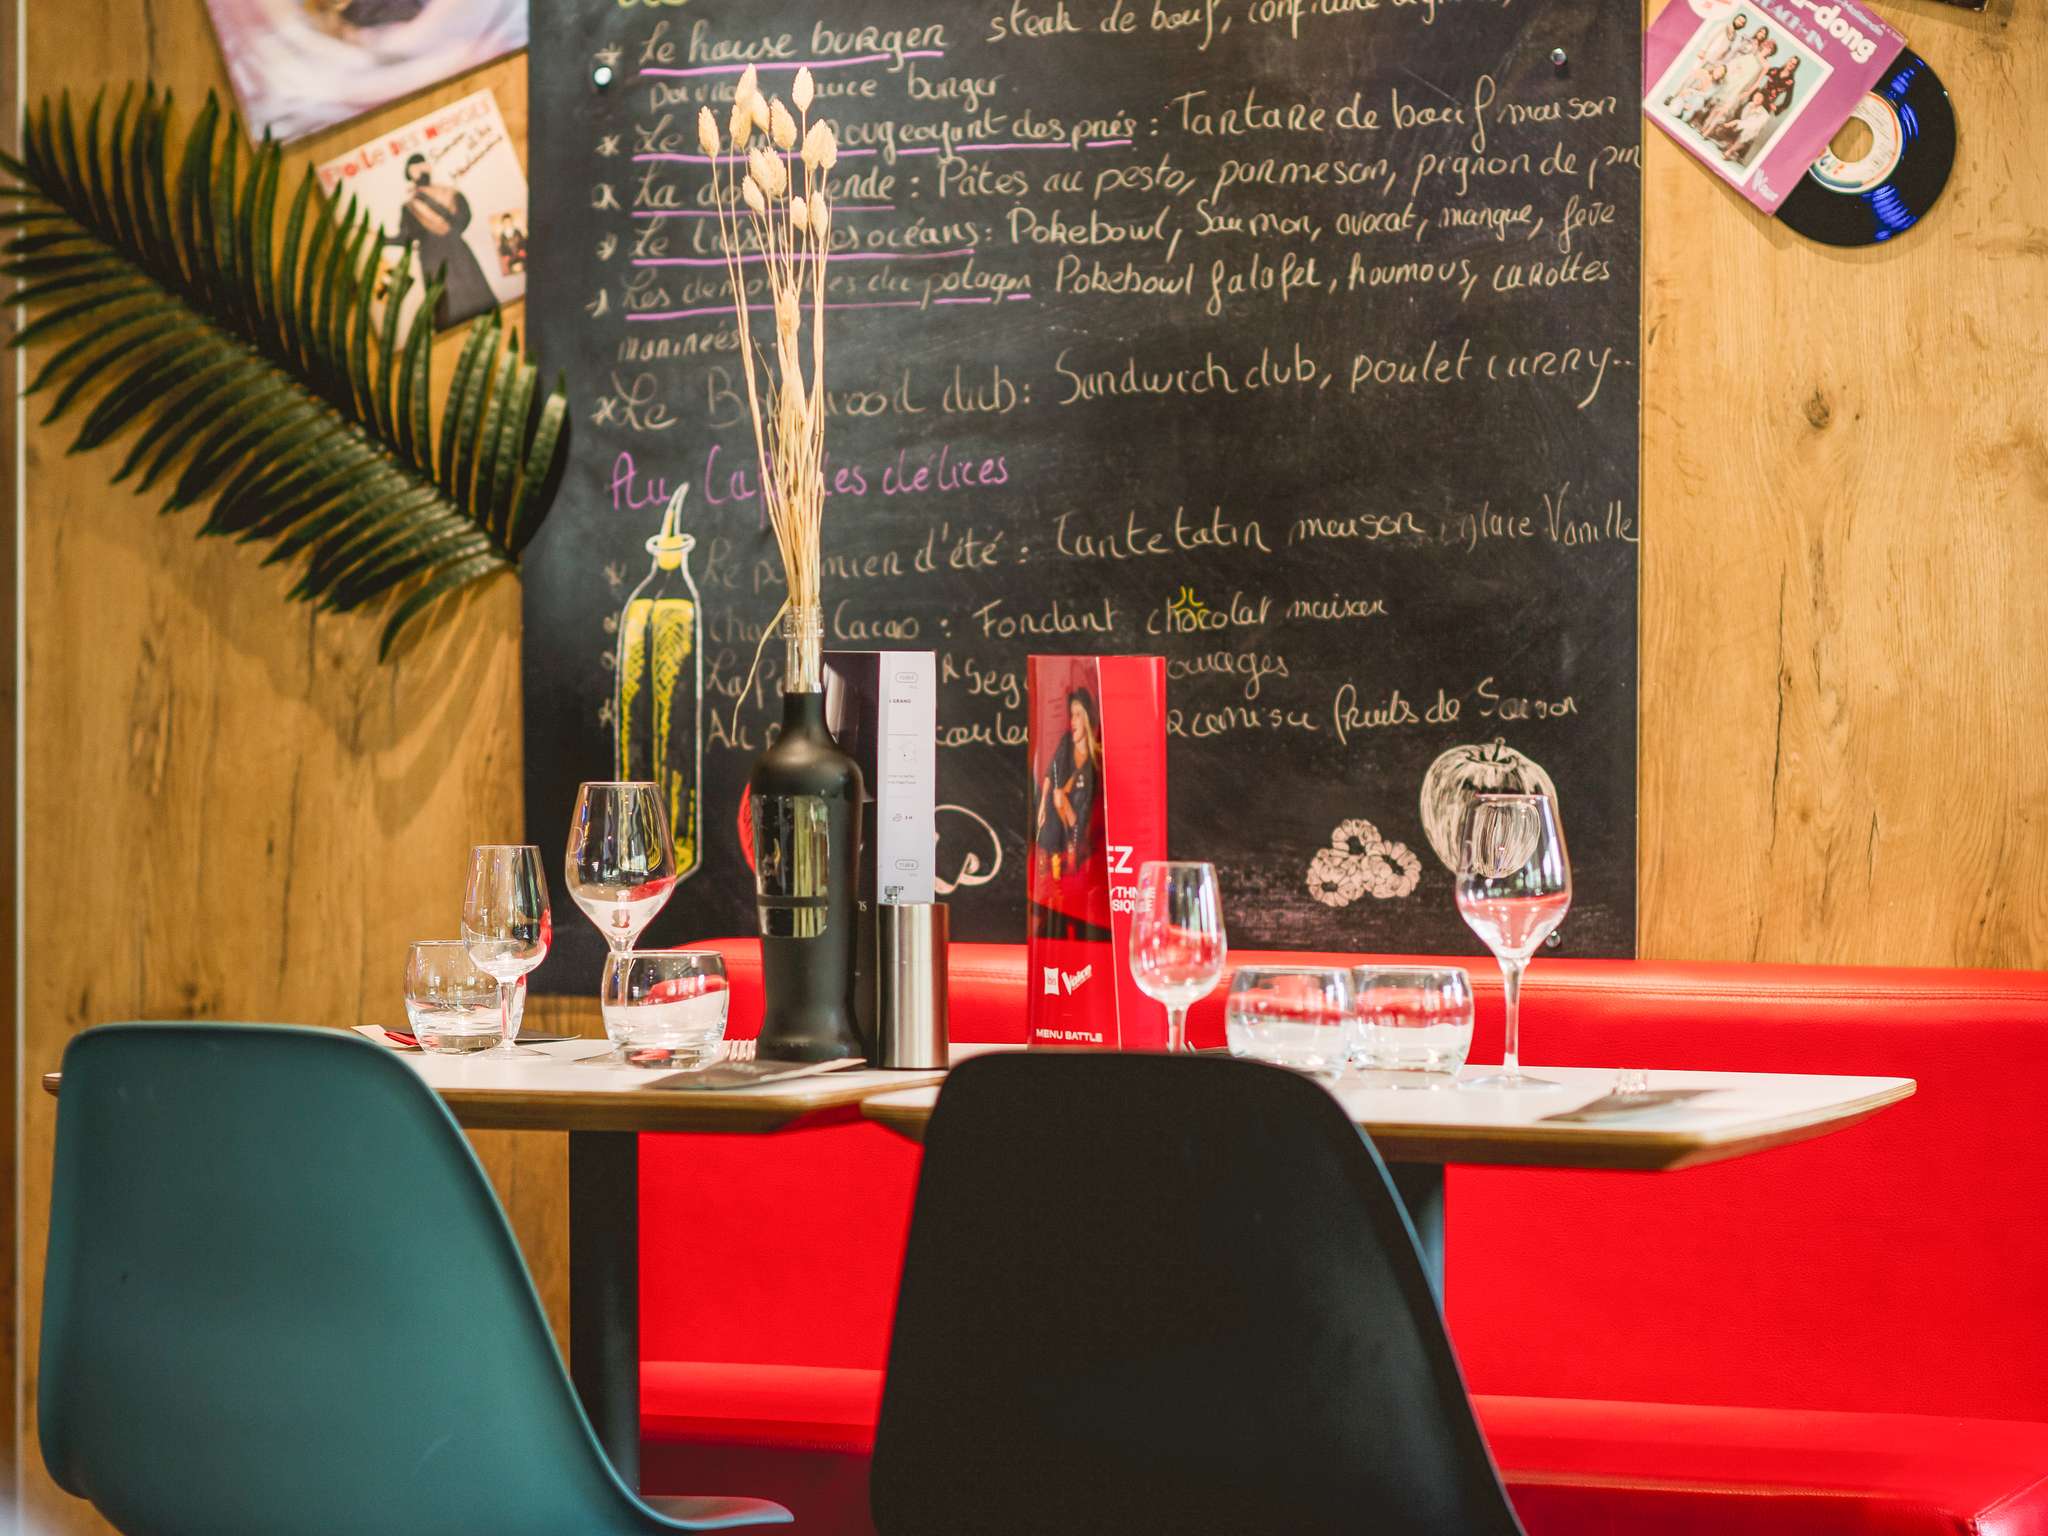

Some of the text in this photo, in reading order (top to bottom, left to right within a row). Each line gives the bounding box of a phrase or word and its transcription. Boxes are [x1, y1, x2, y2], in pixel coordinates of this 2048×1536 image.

[640, 20, 675, 64] Le
[688, 19, 797, 63] house
[811, 19, 947, 72] burger
[986, 1, 1081, 42] steak
[1100, 1, 1136, 33] de
[633, 113, 683, 153] Le
[1012, 109, 1066, 140] des
[1170, 88, 1323, 136] Tartare
[1336, 92, 1378, 130] de
[1499, 96, 1617, 123] maison
[634, 161, 682, 208] La
[937, 156, 1029, 197] Pâtes
[1044, 170, 1084, 193] au
[1095, 154, 1196, 200] pesto,
[1213, 156, 1395, 204] parmesan,
[1412, 152, 1530, 196] pignon
[1540, 141, 1578, 175] de
[628, 215, 669, 257] Le
[1336, 202, 1428, 242] avocat,
[1438, 203, 1543, 241] mangue,
[622, 267, 671, 310] Les
[868, 265, 912, 292] du
[1056, 254, 1194, 294] Pokebowl
[612, 371, 677, 431] Le
[1055, 347, 1239, 405] Sandwich
[1246, 343, 1333, 391] club,
[1350, 339, 1472, 393] poulet
[610, 451, 671, 509] Au
[882, 445, 1009, 496] délices
[914, 522, 1004, 573] d'été
[1053, 509, 1162, 558] Tarte
[1174, 505, 1271, 551] tatin
[1543, 482, 1640, 546] Vanille
[834, 599, 920, 641] Cacao
[972, 598, 1118, 638] Fondant
[1147, 592, 1269, 635] chocolat
[1286, 596, 1389, 618] maison
[1334, 683, 1420, 745] fruits
[1425, 690, 1460, 724] de
[1036, 1028, 1103, 1043] MENU BATTLE
